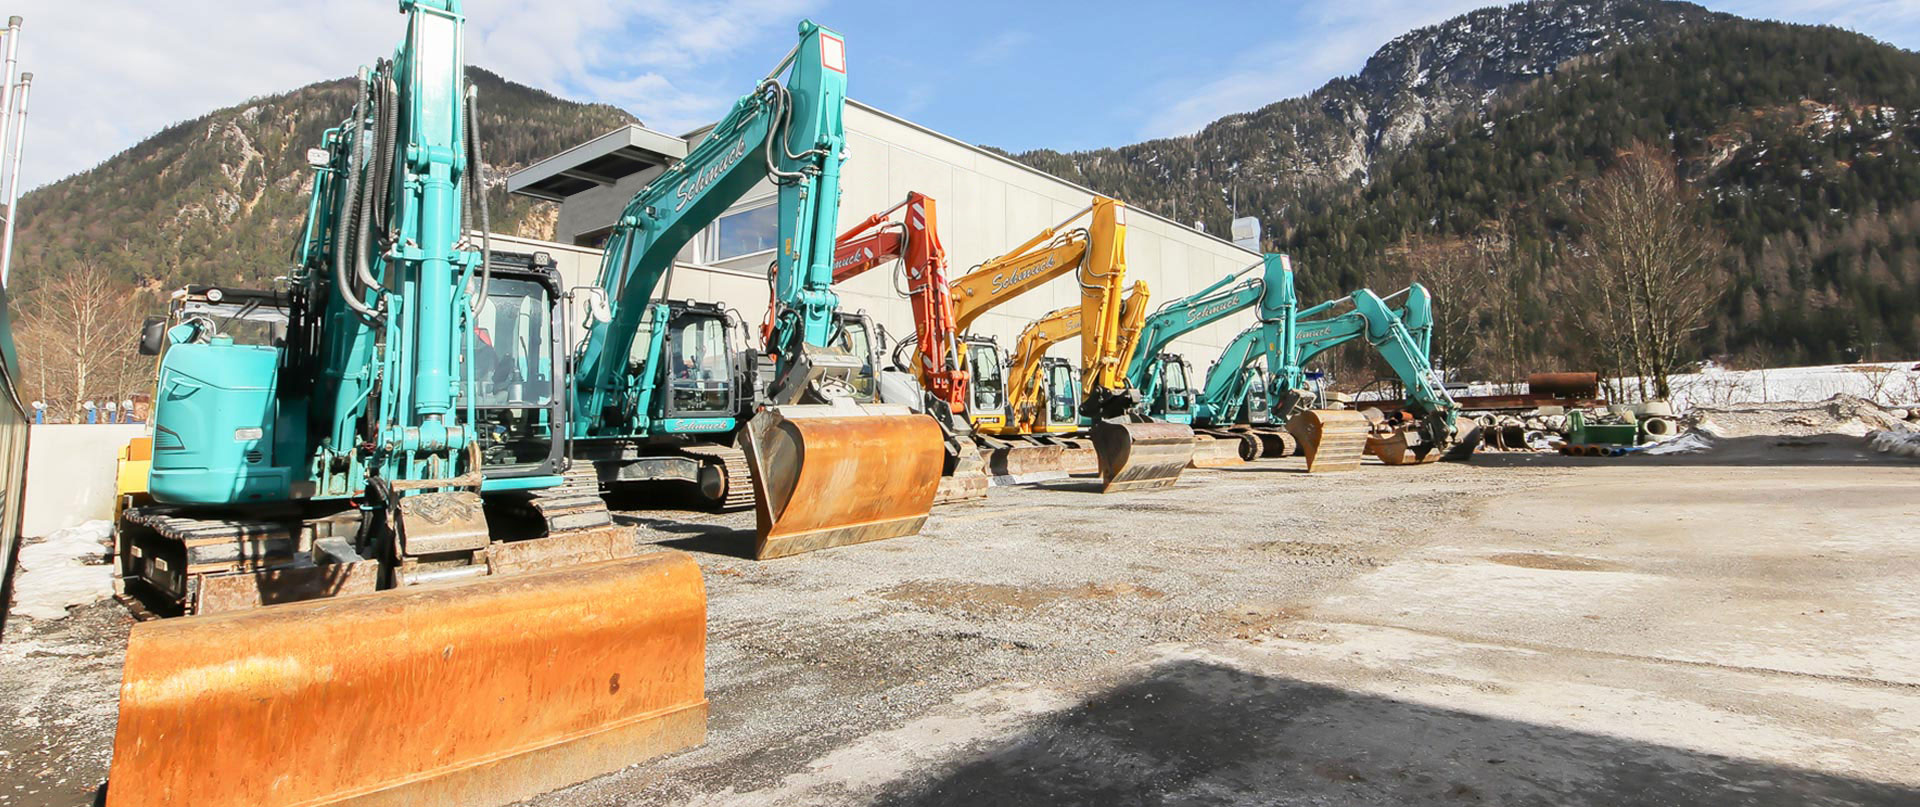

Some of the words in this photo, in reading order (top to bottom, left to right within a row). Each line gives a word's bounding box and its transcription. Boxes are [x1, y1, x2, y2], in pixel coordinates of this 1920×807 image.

[674, 131, 746, 213] Schmuck
[992, 252, 1056, 295] Schmuck
[1187, 295, 1239, 324] Schmuck
[672, 419, 727, 431] Schmuck
